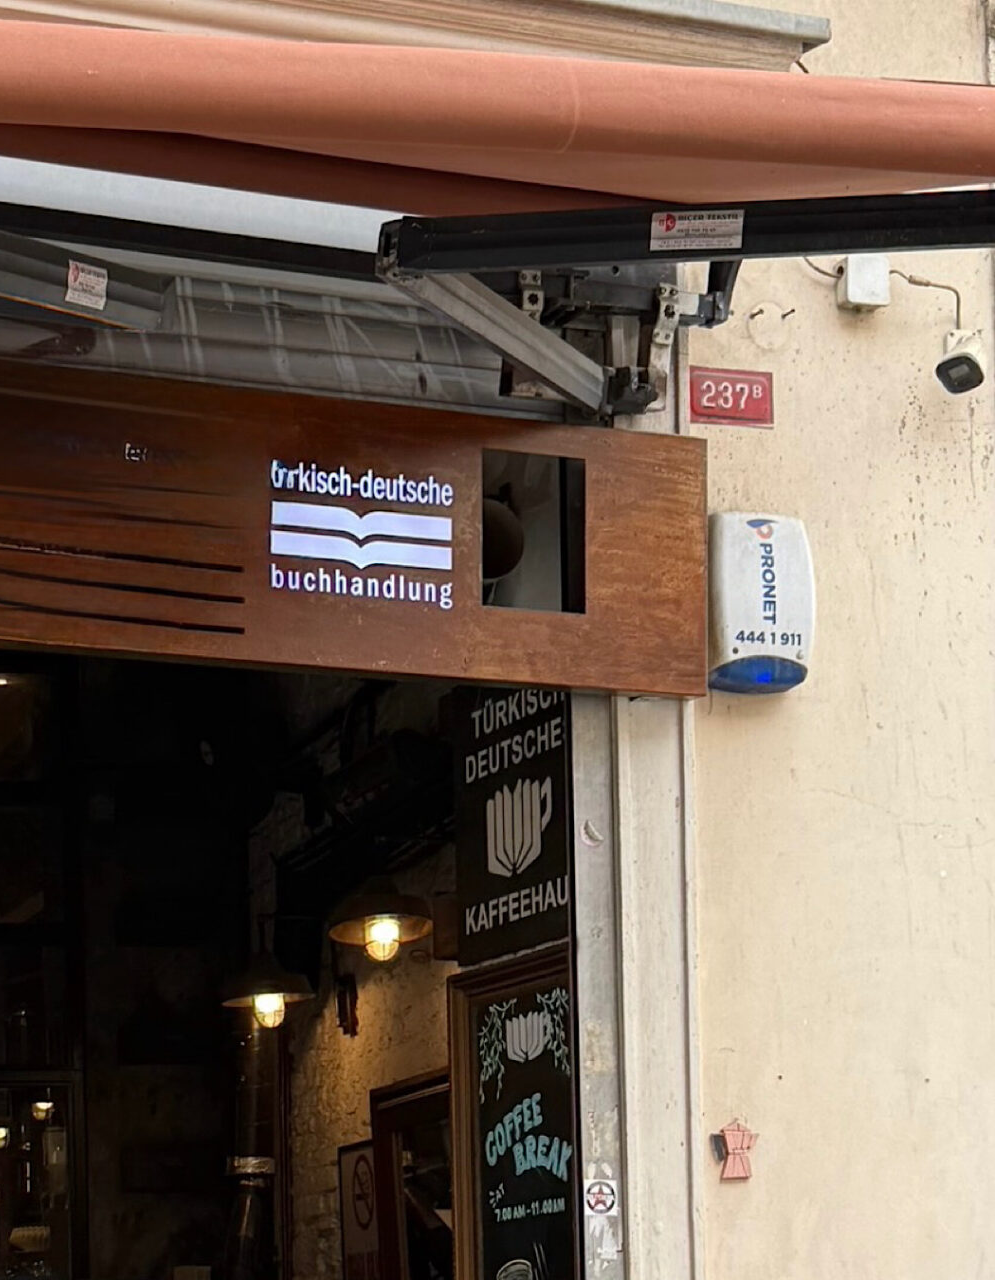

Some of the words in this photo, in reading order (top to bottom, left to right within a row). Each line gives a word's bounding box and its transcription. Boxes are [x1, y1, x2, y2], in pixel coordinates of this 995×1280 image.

[270, 562, 454, 610] buchhandlung
[759, 543, 777, 625] PRONET
[735, 630, 766, 644] 444
[770, 632, 777, 645] 1
[780, 632, 802, 646] 911
[465, 715, 564, 785] DEUTSCHE
[485, 1092, 543, 1167] COFFEE
[512, 1134, 573, 1183] BREAK
